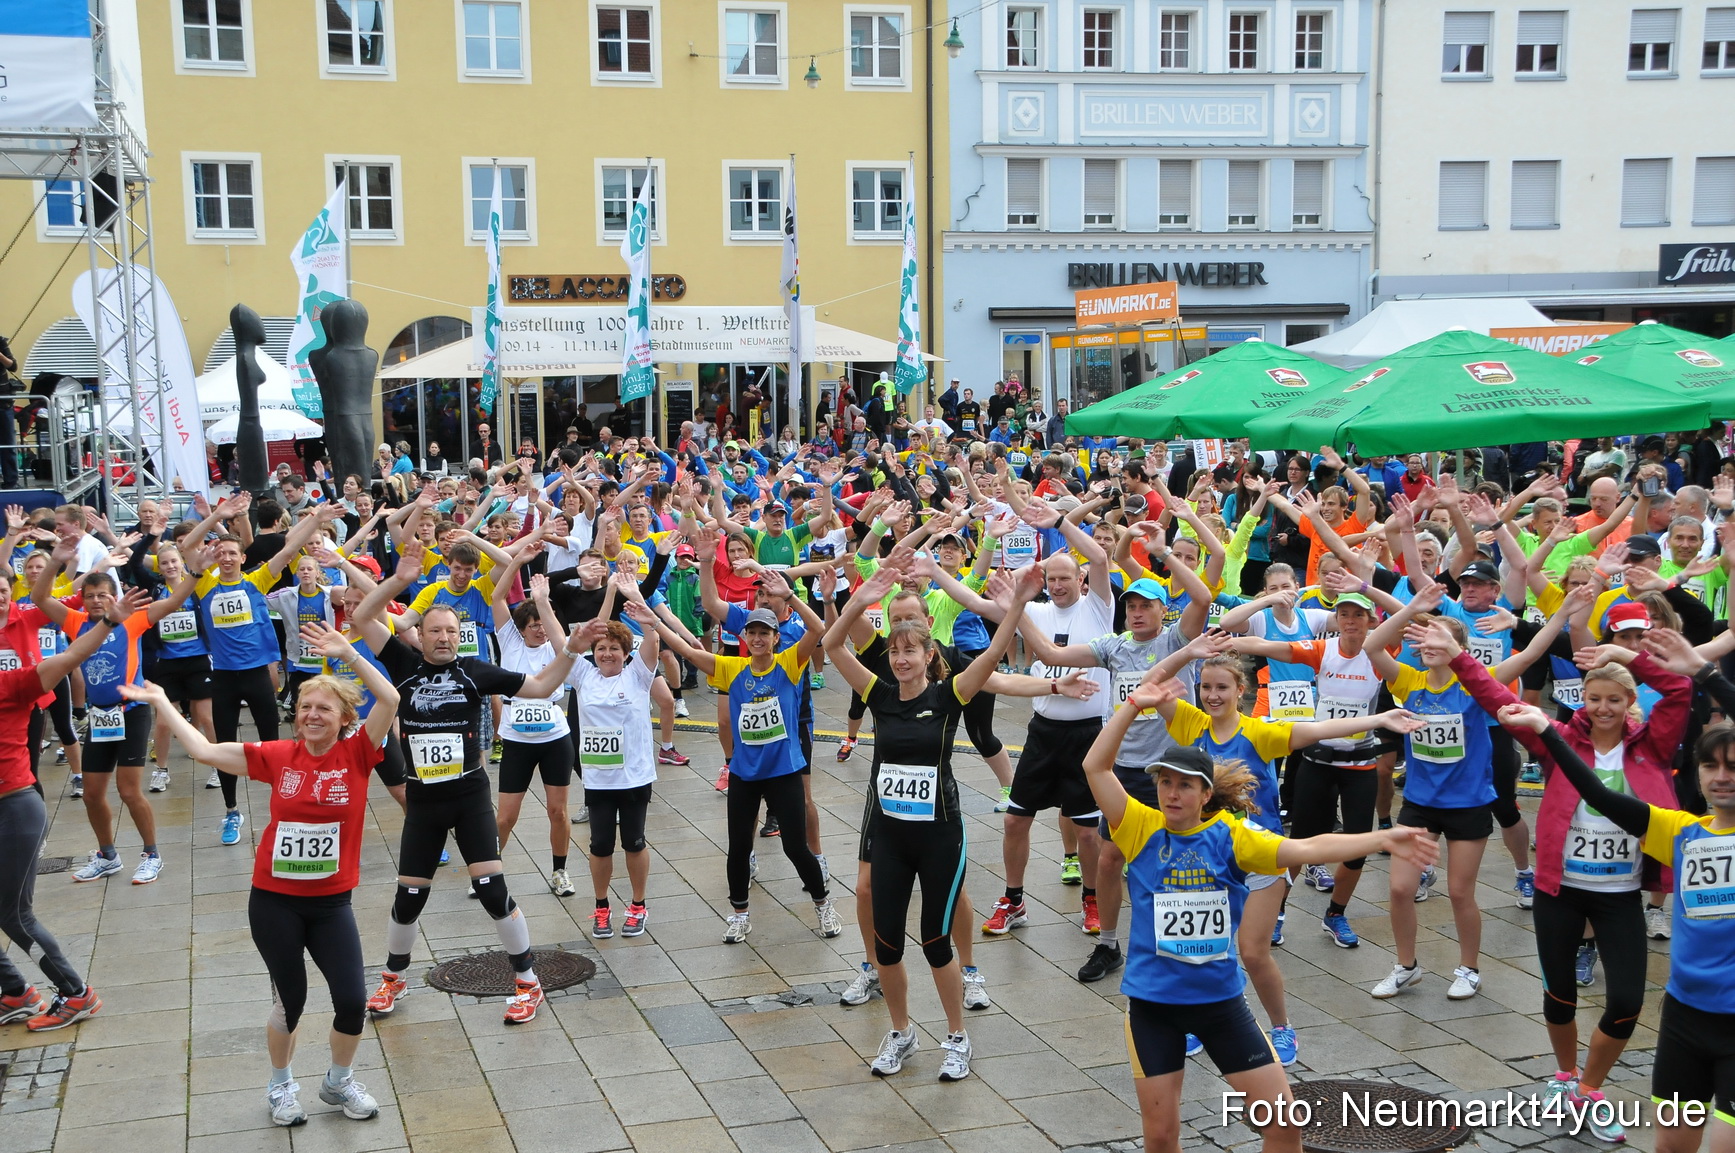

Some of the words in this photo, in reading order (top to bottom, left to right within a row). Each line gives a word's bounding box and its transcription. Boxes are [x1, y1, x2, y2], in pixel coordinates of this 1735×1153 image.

[1091, 103, 1175, 124] BRILLEN
[1179, 103, 1257, 125] WEBER
[1068, 263, 1168, 287] BRILLEN
[1173, 262, 1269, 286] WEBER
[511, 277, 685, 299] BELACCATO
[1078, 293, 1172, 316] RUNMARKT.DE
[485, 317, 586, 334] usstellung
[598, 317, 626, 331] 100
[651, 316, 685, 333] ahre
[697, 316, 710, 330] 1.
[722, 315, 790, 331] Weltkrie
[500, 340, 541, 352] .09.14
[564, 340, 618, 352] 11.11.14
[650, 339, 733, 351] Stadtmuseum
[740, 337, 790, 346] NEUMARKT
[1455, 387, 1561, 402] Neumarkter
[205, 404, 229, 414] uns,
[1441, 395, 1593, 415] Lammsbräu
[1008, 537, 1031, 548] 2895
[16, 562, 23, 573] 5
[218, 599, 244, 614] 164
[163, 619, 193, 633] 5145
[299, 645, 323, 657] 512
[1335, 673, 1368, 681] KLEBL
[1278, 690, 1307, 706] 242
[515, 708, 551, 723] 2650
[742, 709, 779, 730] 5218
[752, 731, 774, 740] Sabine
[1414, 727, 1458, 744] 5134
[583, 737, 620, 753] 5520
[420, 746, 453, 764] 183
[422, 767, 450, 776] Michael
[883, 777, 930, 800] 2448
[895, 803, 913, 812] Ruth
[1569, 826, 1590, 834] PARTL
[280, 836, 334, 858] 5132
[1573, 836, 1630, 859] 2134
[1683, 847, 1699, 855] ARTL
[287, 863, 324, 871] Theresia
[1582, 864, 1617, 874] Corina
[1686, 855, 1732, 886] 257
[1184, 899, 1219, 907] Neumarkt
[1163, 908, 1225, 936] 2379
[1176, 943, 1213, 954] Daniela
